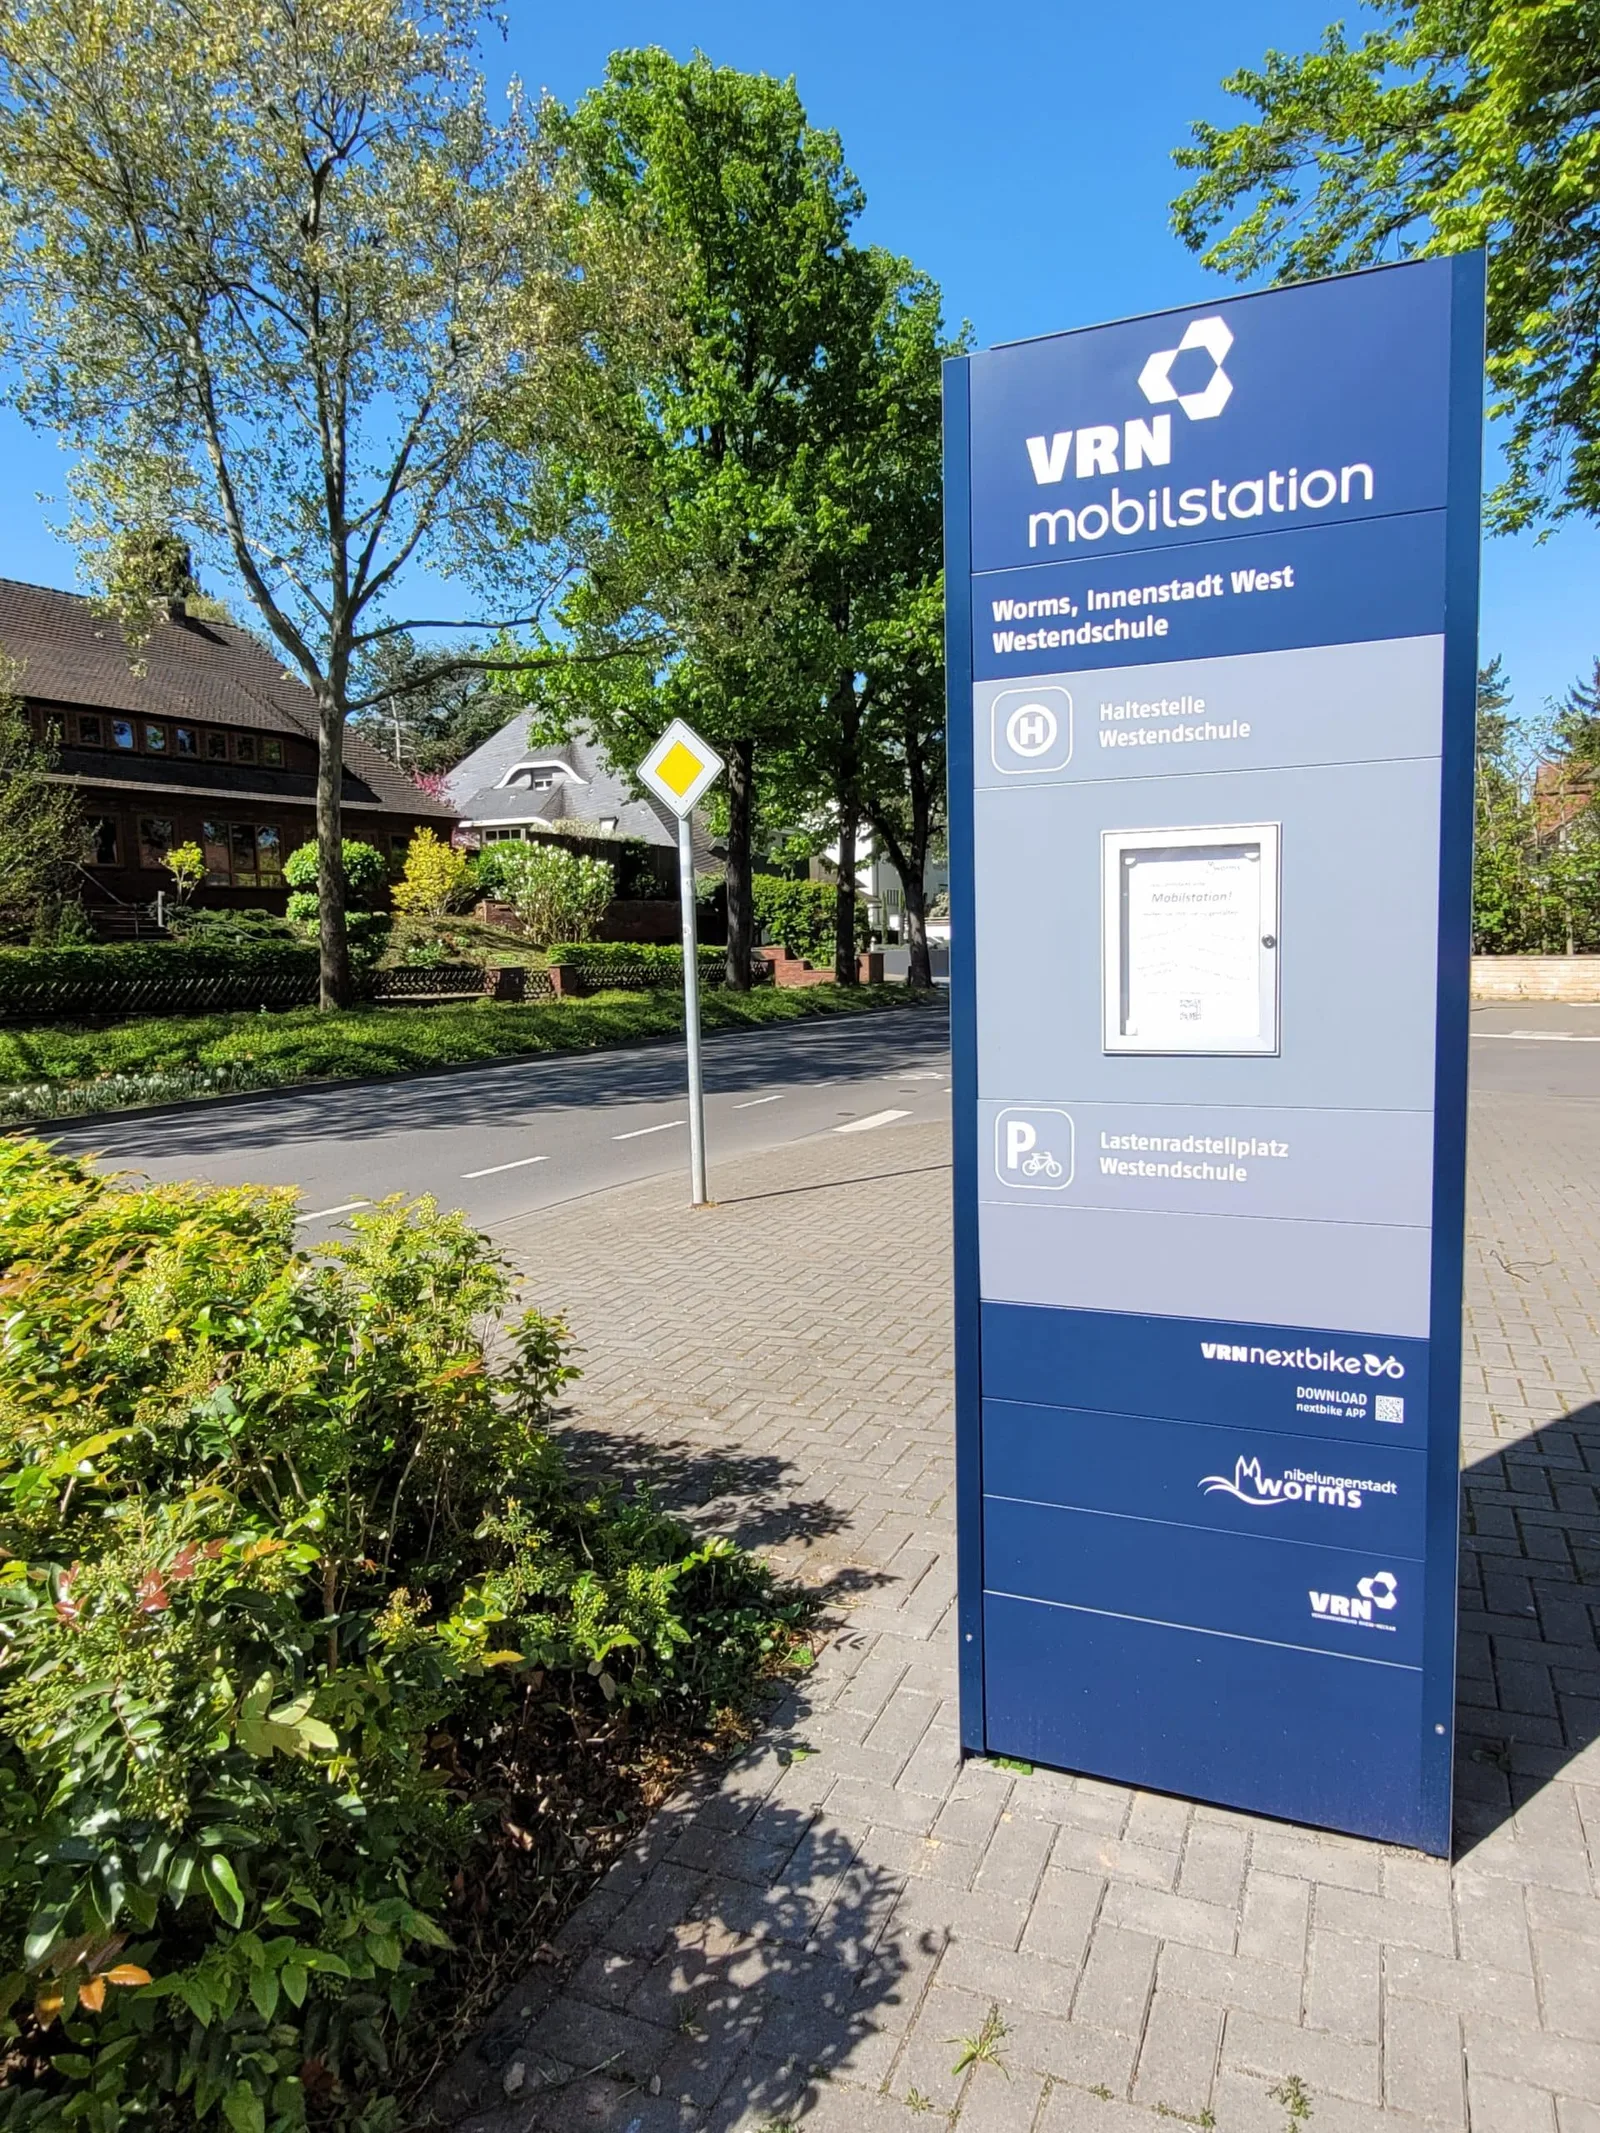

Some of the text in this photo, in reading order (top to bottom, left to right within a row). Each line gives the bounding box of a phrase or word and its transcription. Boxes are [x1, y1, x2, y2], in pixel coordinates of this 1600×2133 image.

[1026, 414, 1171, 485] VRN
[1029, 463, 1374, 547] mobilstation
[992, 565, 1294, 622] Worms, Innenstadt West
[992, 614, 1169, 653] Westendschule
[1100, 696, 1205, 721] Haltestelle
[1099, 720, 1251, 747] Westendschule
[1151, 891, 1232, 903] Mobilstation!
[1007, 1120, 1036, 1169] P
[1100, 1131, 1289, 1158] Lastenradstellplatz
[1099, 1157, 1247, 1182] Westendschule
[1296, 1386, 1368, 1405] DOWNLOAD
[1296, 1402, 1366, 1418] nextbike APP
[1255, 1475, 1362, 1508] worms
[1284, 1468, 1398, 1494] nibelungenstadt
[1308, 1591, 1371, 1620] VRN
